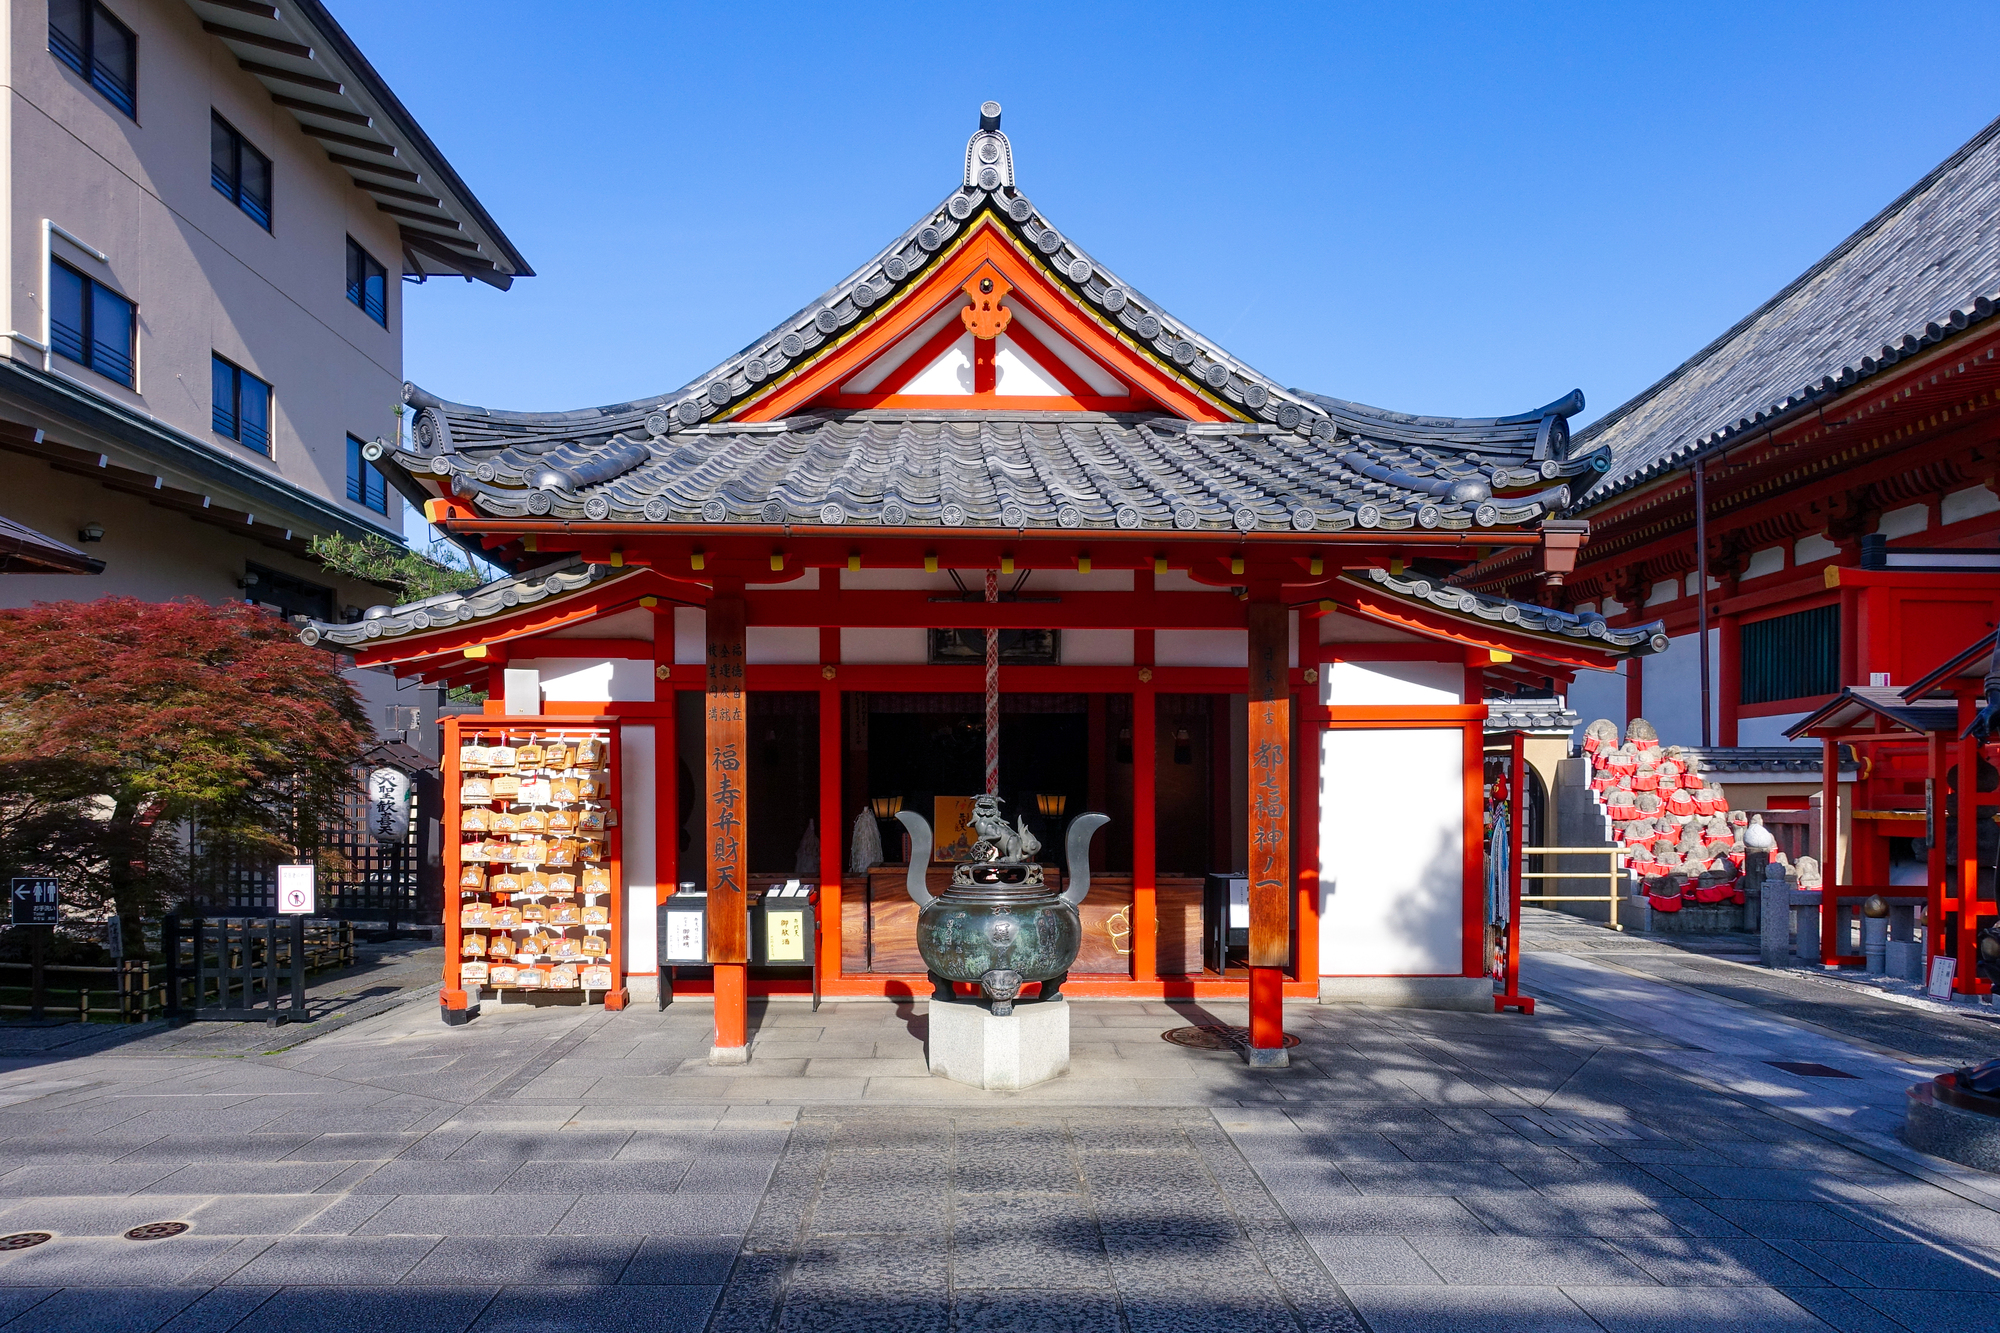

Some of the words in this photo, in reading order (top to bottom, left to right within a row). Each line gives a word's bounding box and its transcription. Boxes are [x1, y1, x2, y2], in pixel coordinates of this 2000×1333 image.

[708, 642, 718, 722] 技芸円満
[719, 644, 731, 722] 金運成就
[732, 643, 743, 721] 福徳自在
[711, 743, 741, 893] 福寿弁財天
[1252, 738, 1285, 889] 都七福神ノ一
